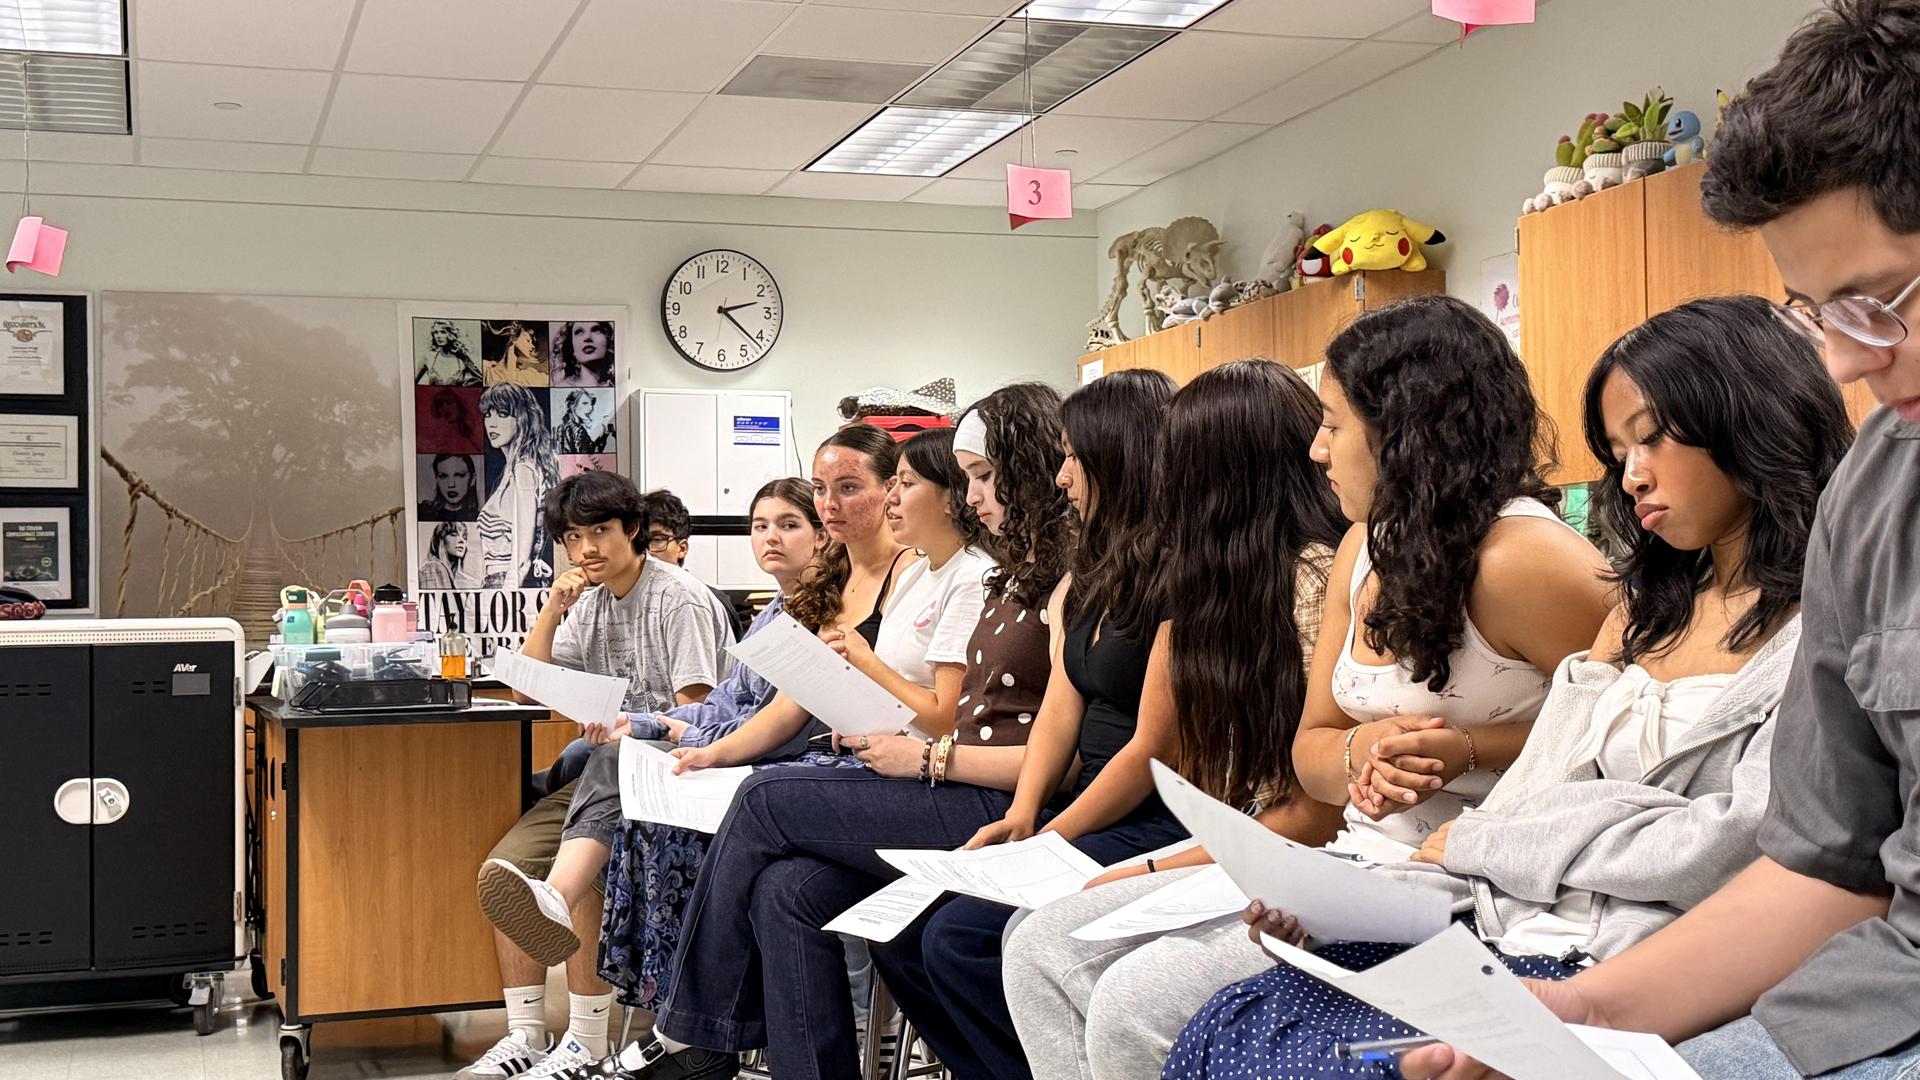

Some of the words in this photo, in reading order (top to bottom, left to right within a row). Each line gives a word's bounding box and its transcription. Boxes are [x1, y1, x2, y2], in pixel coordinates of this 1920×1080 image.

[1028, 179, 1042, 206] 3
[696, 265, 705, 279] 11
[716, 259, 729, 274] 12
[679, 281, 692, 295] 10
[756, 283, 765, 298] 2
[671, 301, 680, 316] 9
[763, 306, 772, 320] 3
[678, 325, 688, 339] 8
[755, 329, 765, 342] 4
[695, 341, 704, 355] 7
[717, 348, 726, 362] 6
[739, 344, 748, 358] 5
[419, 591, 528, 634] TAYLOR
